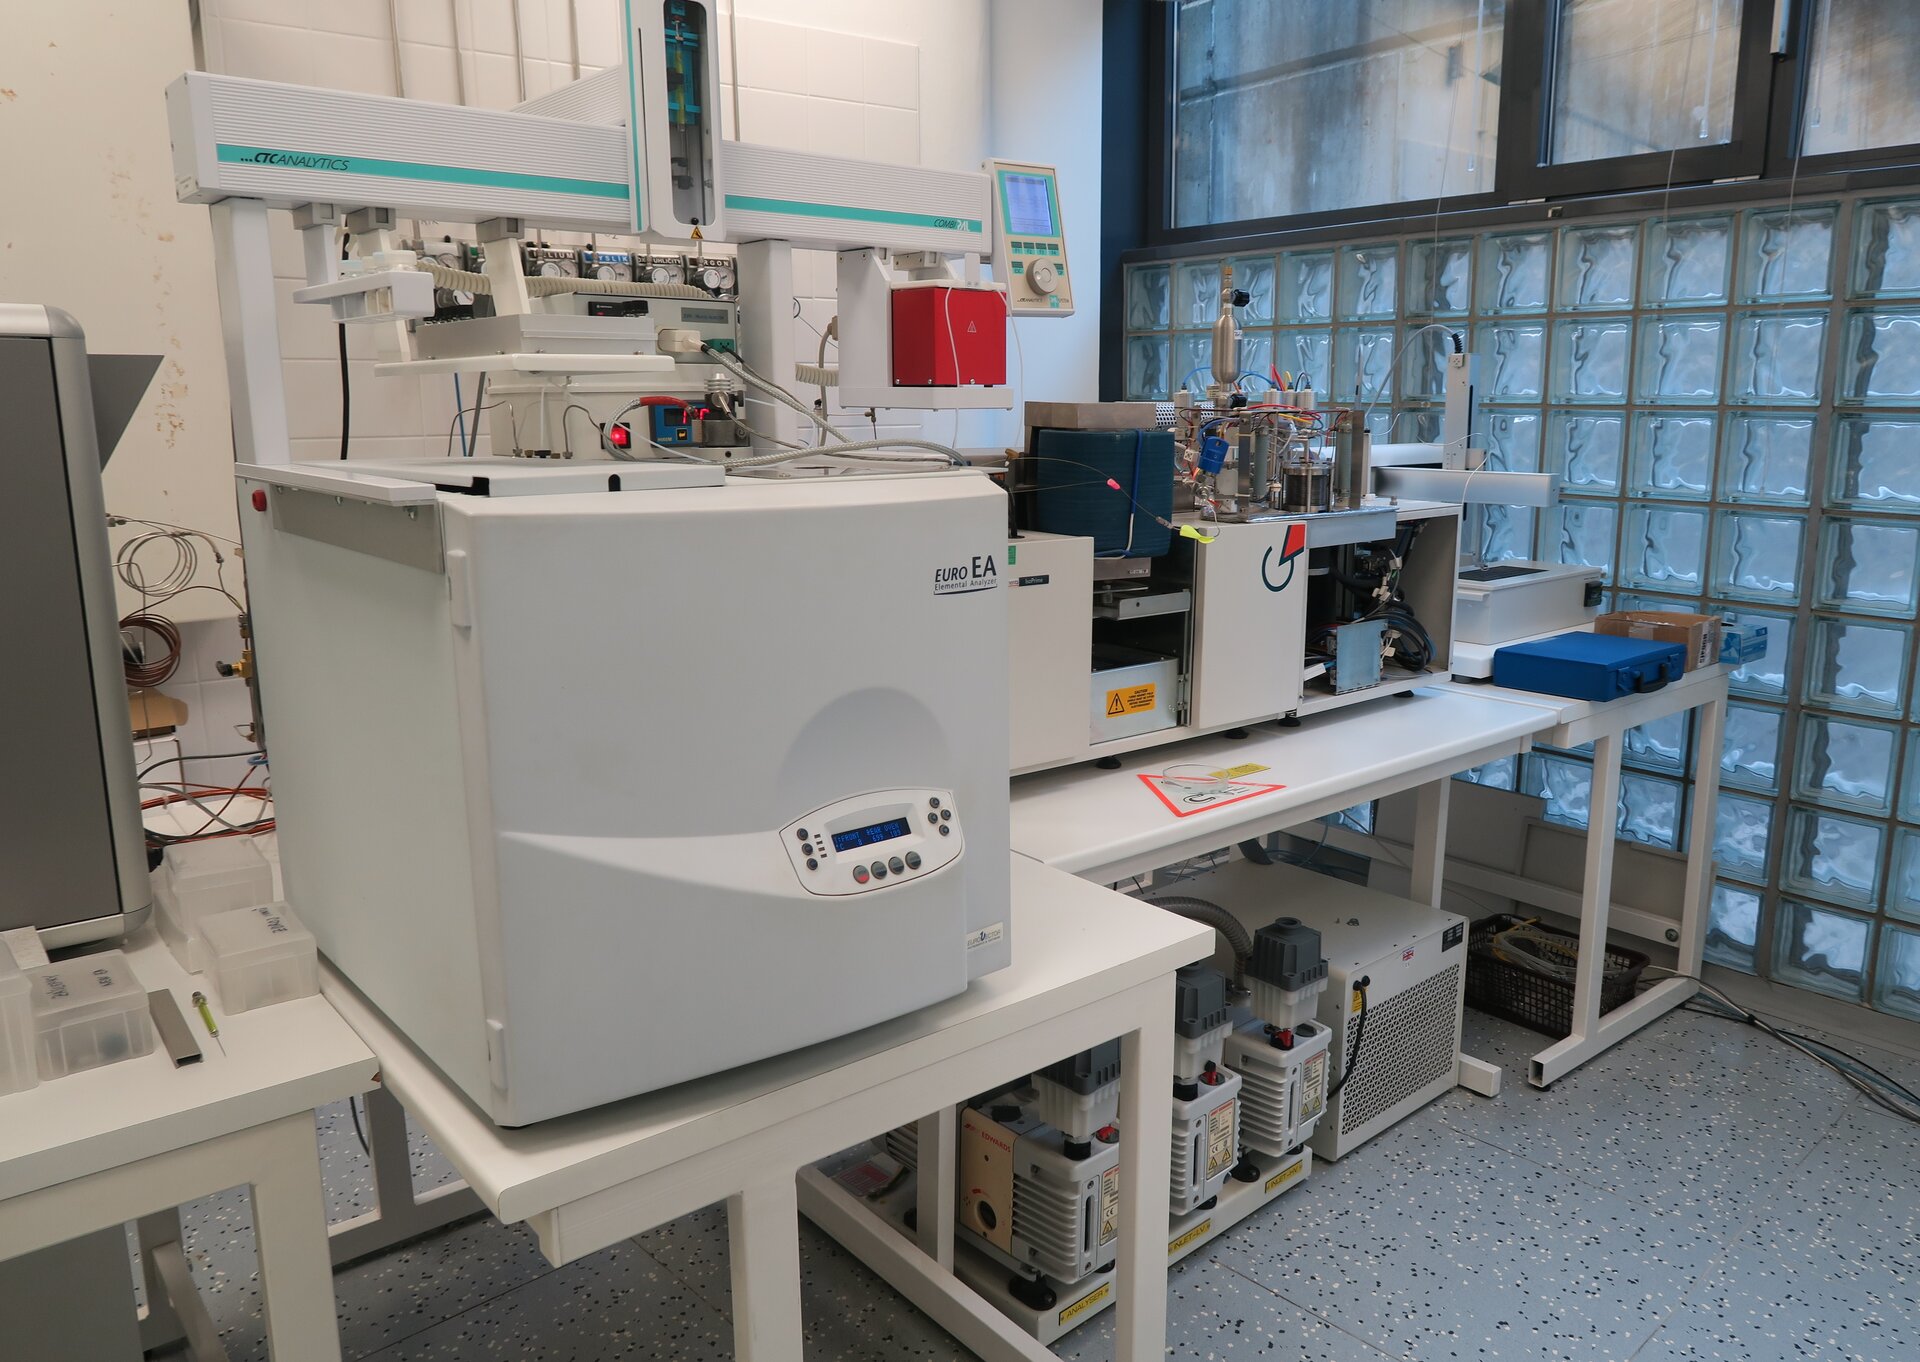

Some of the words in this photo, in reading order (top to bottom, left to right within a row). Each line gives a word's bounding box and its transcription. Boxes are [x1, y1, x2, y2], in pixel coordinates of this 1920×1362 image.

[703, 259, 729, 267] RGON
[935, 566, 968, 583] EURO
[971, 554, 997, 579] EA
[934, 581, 968, 591] Elemental
[970, 578, 997, 587] Analyzer
[981, 1131, 1011, 1153] EDWARDS
[1066, 1289, 1105, 1318] ANALYSER
